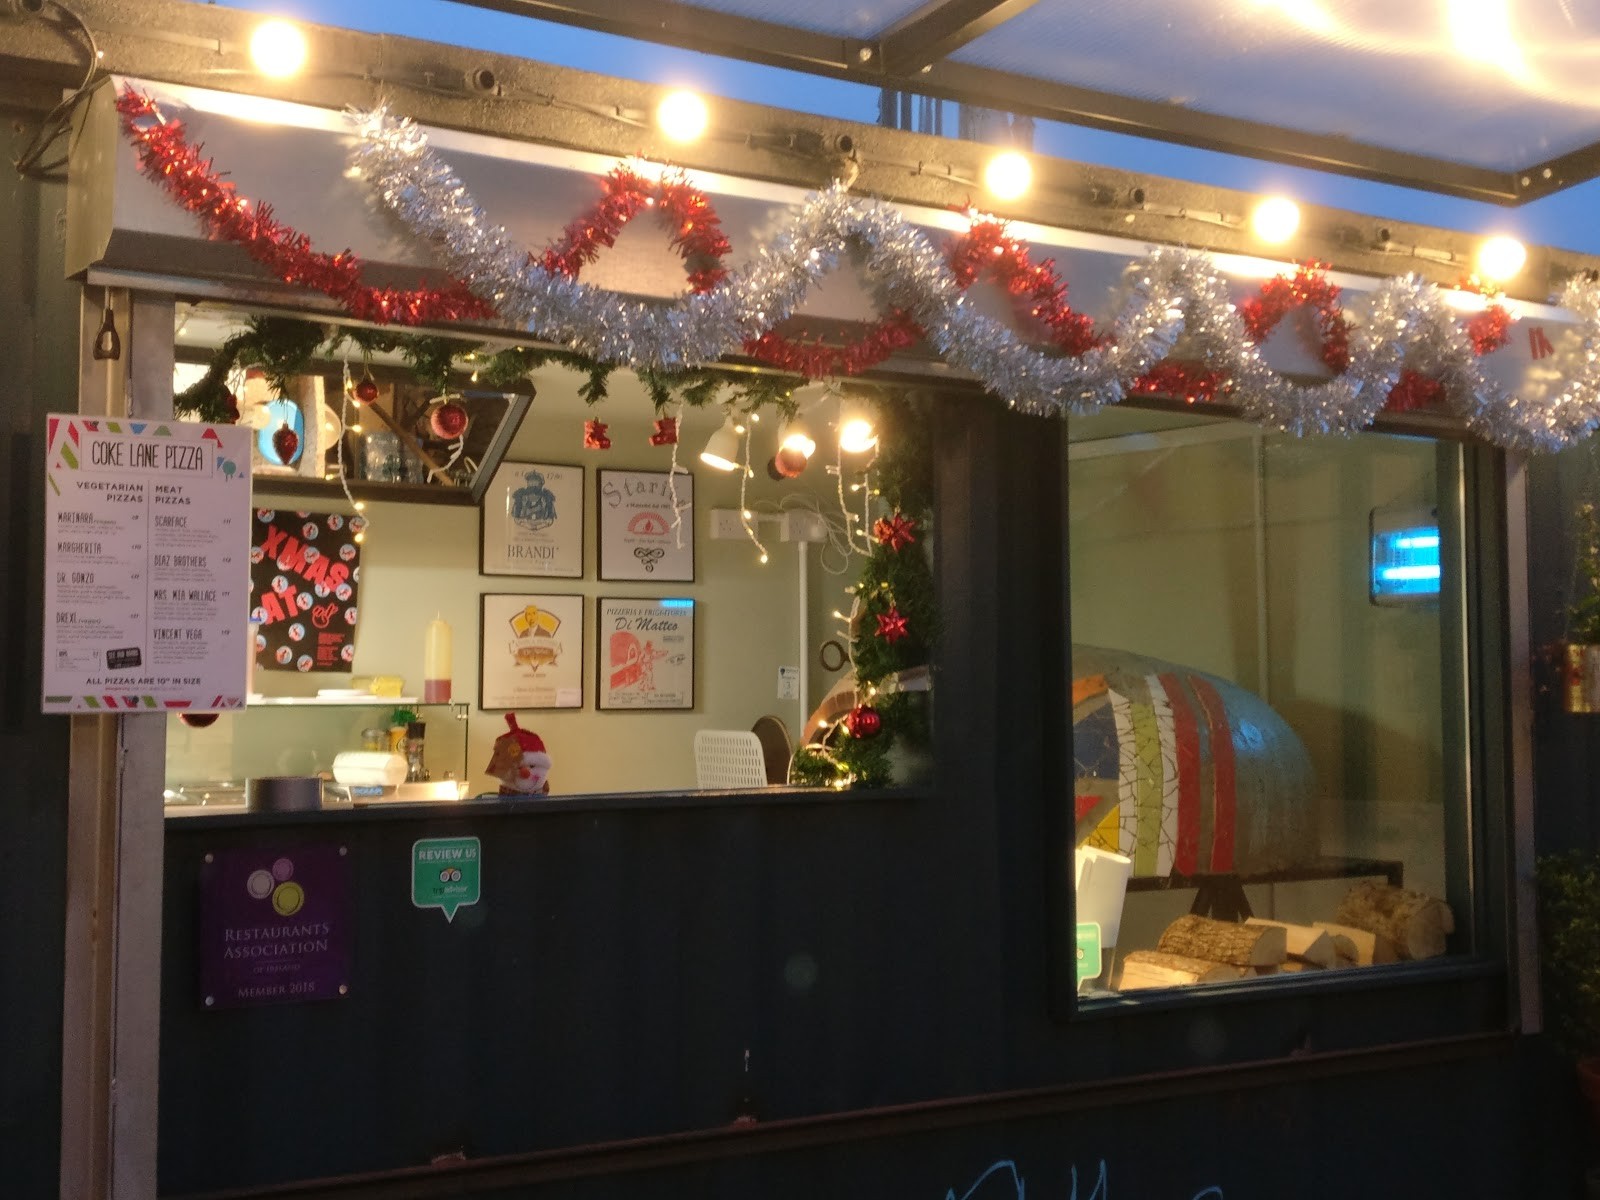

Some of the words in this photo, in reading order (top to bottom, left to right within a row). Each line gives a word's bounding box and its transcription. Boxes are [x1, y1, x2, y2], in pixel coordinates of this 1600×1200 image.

[92, 440, 125, 467] COKE
[130, 442, 159, 469] LANE
[165, 444, 203, 471] PIZZA
[76, 481, 144, 492] VEGETARIAN
[155, 485, 183, 494] MEAT
[106, 494, 143, 503] PIZZAS
[155, 496, 191, 505] PIZZAS
[57, 512, 94, 524] MARINARA
[154, 515, 188, 528] SCARFACE
[57, 541, 102, 554] MARGHERITA
[154, 554, 171, 567] DIAZ
[173, 555, 207, 568] BROTHERS
[261, 523, 349, 592] XMAS
[71, 572, 95, 584] GONZO
[154, 589, 167, 600] MRS
[172, 589, 186, 600] MIA
[188, 590, 217, 602] WALLACE
[261, 585, 298, 625] AT
[614, 617, 632, 631] Di
[635, 617, 679, 632] Matteo
[153, 628, 182, 640] VINCENT
[185, 629, 203, 640] VEGA
[86, 677, 102, 685] ALL
[104, 677, 136, 685] PIZZAS
[137, 677, 155, 685] ARE
[418, 847, 463, 861] REVIEW
[465, 848, 477, 859] US
[224, 922, 330, 943] RESTAURANTS
[223, 938, 329, 960] ASSOCIATION
[238, 984, 287, 999] MEMBER
